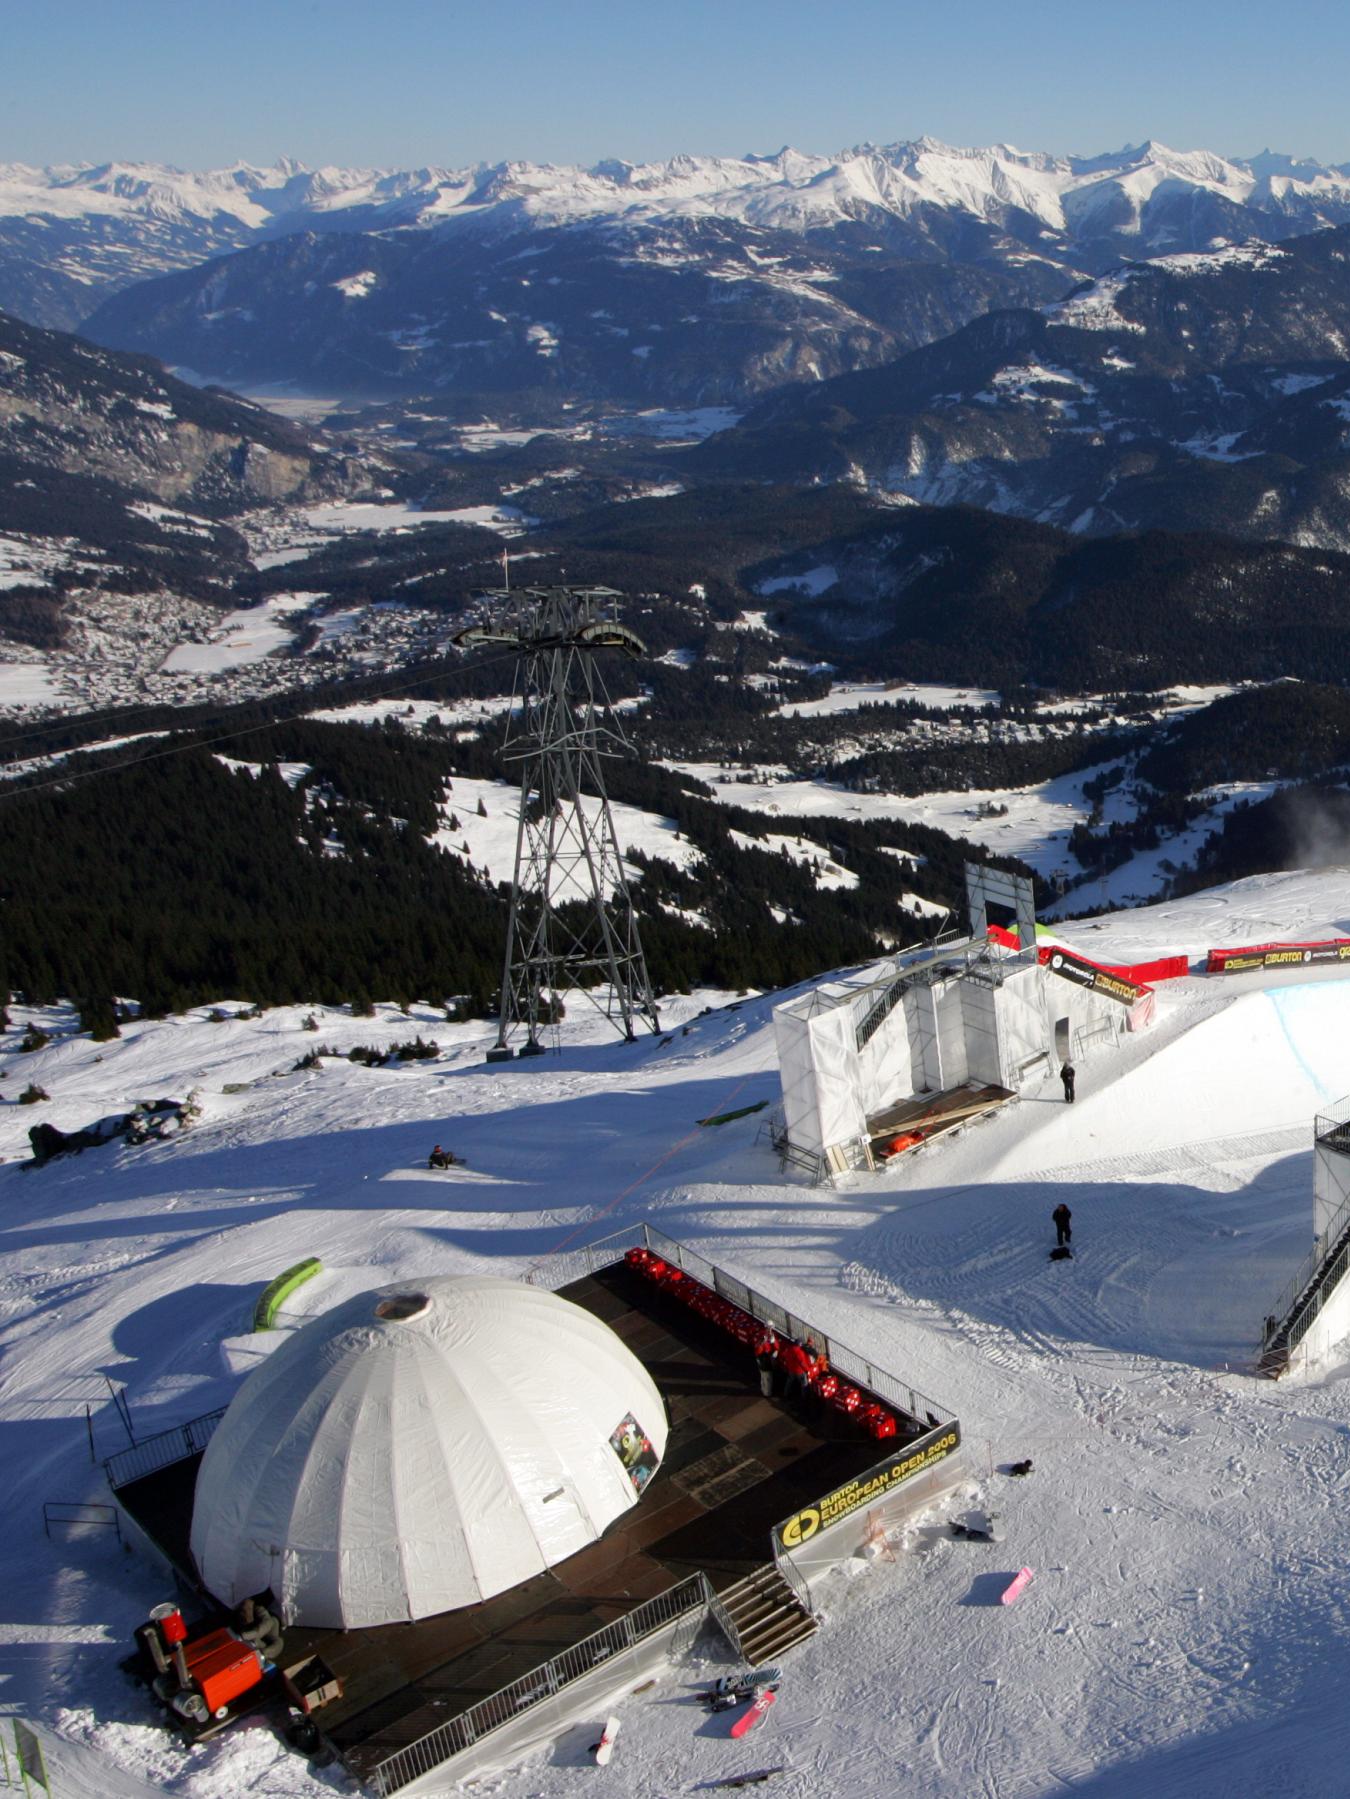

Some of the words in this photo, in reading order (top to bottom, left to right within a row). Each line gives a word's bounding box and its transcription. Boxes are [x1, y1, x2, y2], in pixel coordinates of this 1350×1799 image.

[1102, 975, 1137, 1000] BURTON
[820, 1481, 859, 1509] BURTON
[821, 1472, 889, 1520] EUROPEAN
[892, 1451, 925, 1477] OPEN
[927, 1433, 956, 1456] 2006
[823, 1486, 885, 1527] SNOWBOARDING
[886, 1450, 947, 1488] CHAMPIONSHIPS
